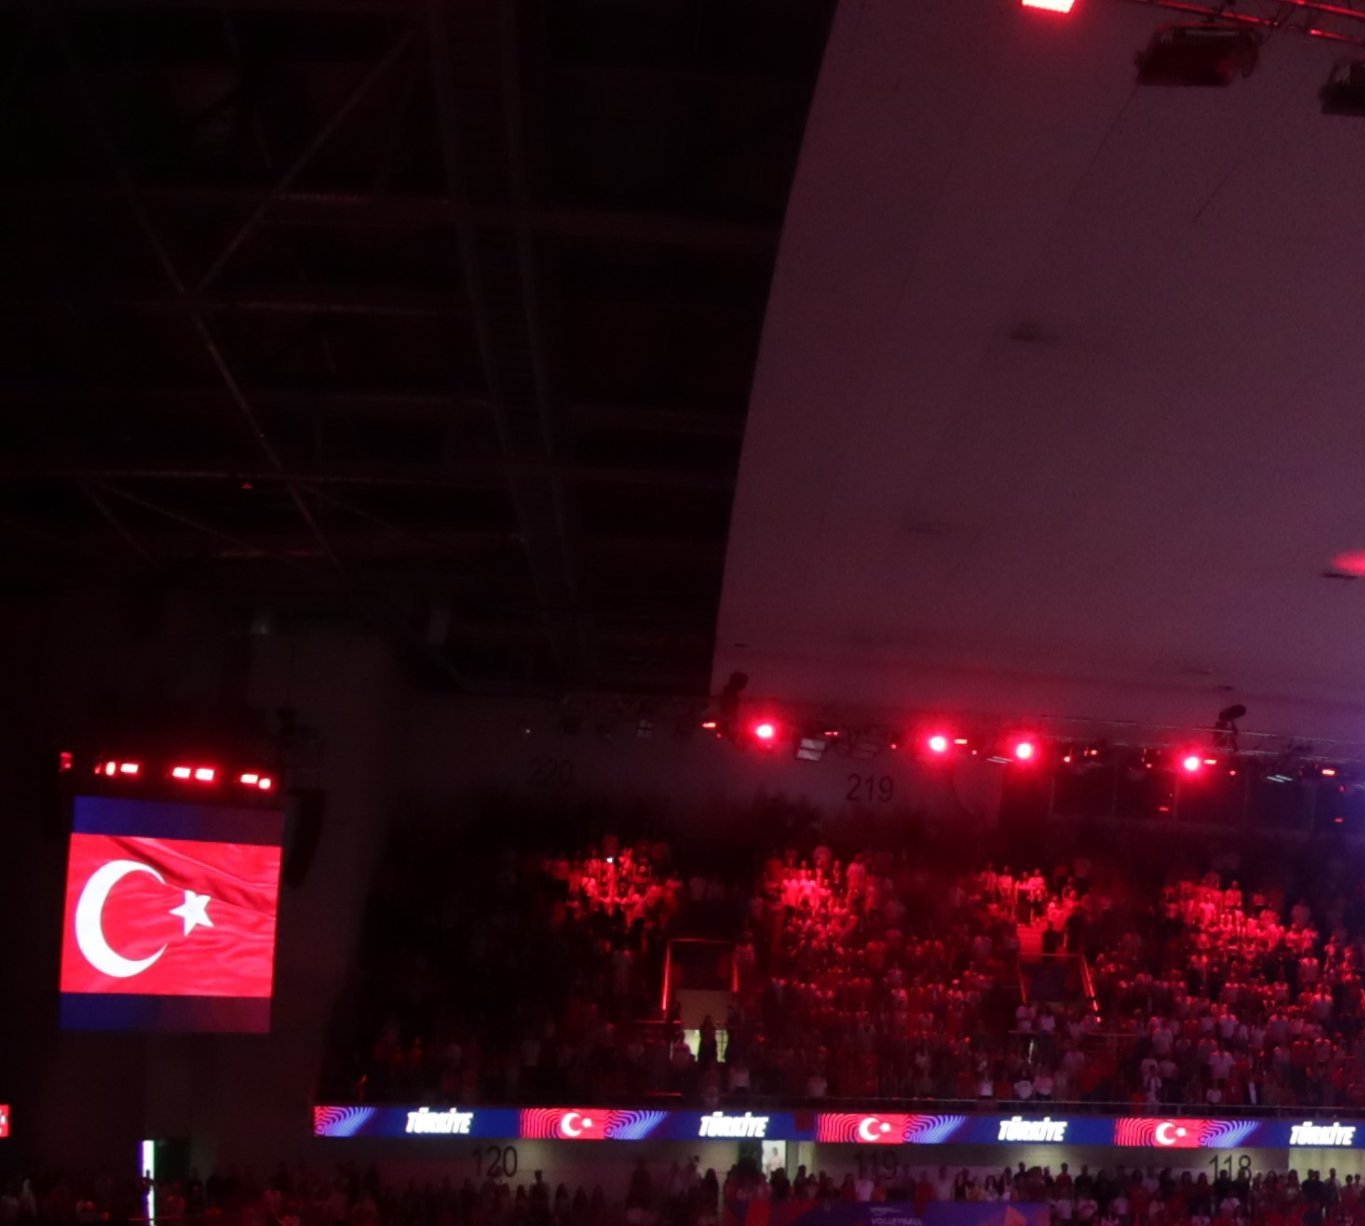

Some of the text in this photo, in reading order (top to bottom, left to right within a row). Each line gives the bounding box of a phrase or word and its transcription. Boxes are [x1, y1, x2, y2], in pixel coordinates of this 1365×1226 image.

[527, 757, 575, 786] 220
[845, 773, 895, 803] 219
[406, 1107, 473, 1134] TÜRKİYE
[699, 1111, 769, 1138] TÜRKİYE
[998, 1116, 1067, 1142] TÜRKİYE
[1290, 1121, 1356, 1146] TÜRKİYE
[472, 1145, 518, 1178] 120
[853, 1149, 898, 1181] 119
[1208, 1154, 1252, 1181] 118
